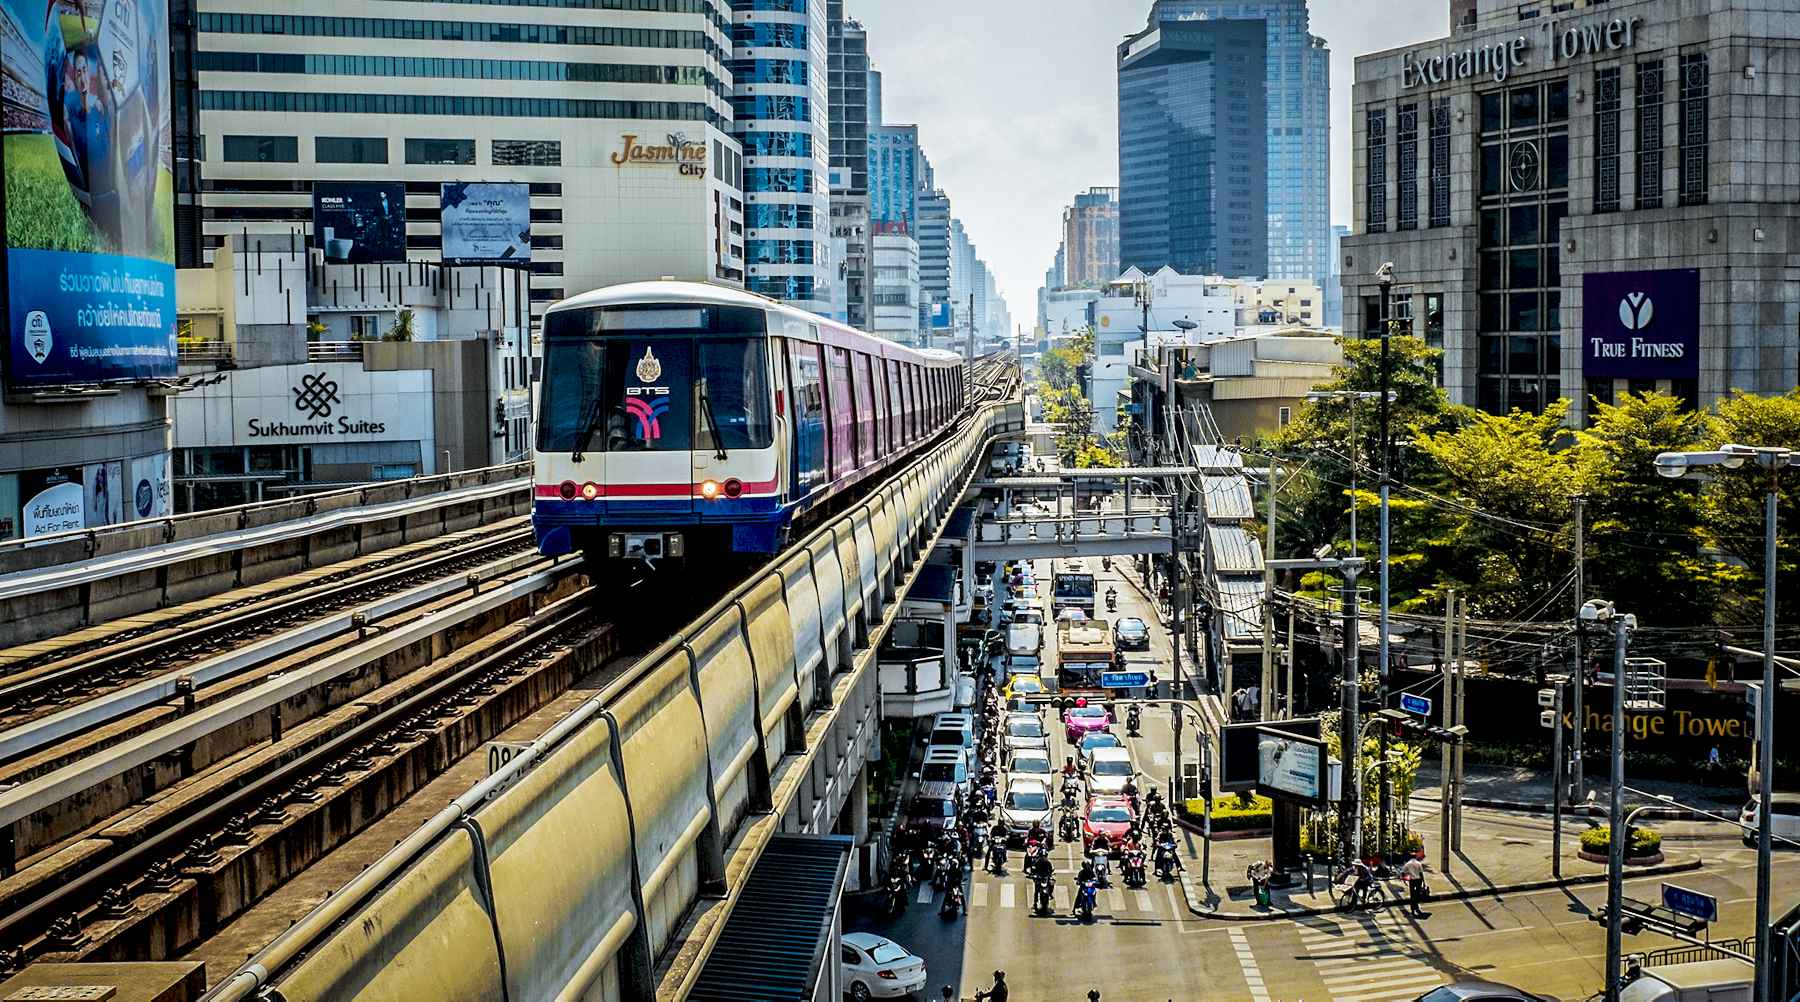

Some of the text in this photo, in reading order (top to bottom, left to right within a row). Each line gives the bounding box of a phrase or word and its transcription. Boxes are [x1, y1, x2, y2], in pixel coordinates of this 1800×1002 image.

[1401, 14, 1642, 89] Exchange Tower
[611, 132, 706, 164] Jasmine
[680, 163, 707, 179] City
[626, 386, 670, 395] BTS
[248, 415, 386, 437] Sukhumvit Suites
